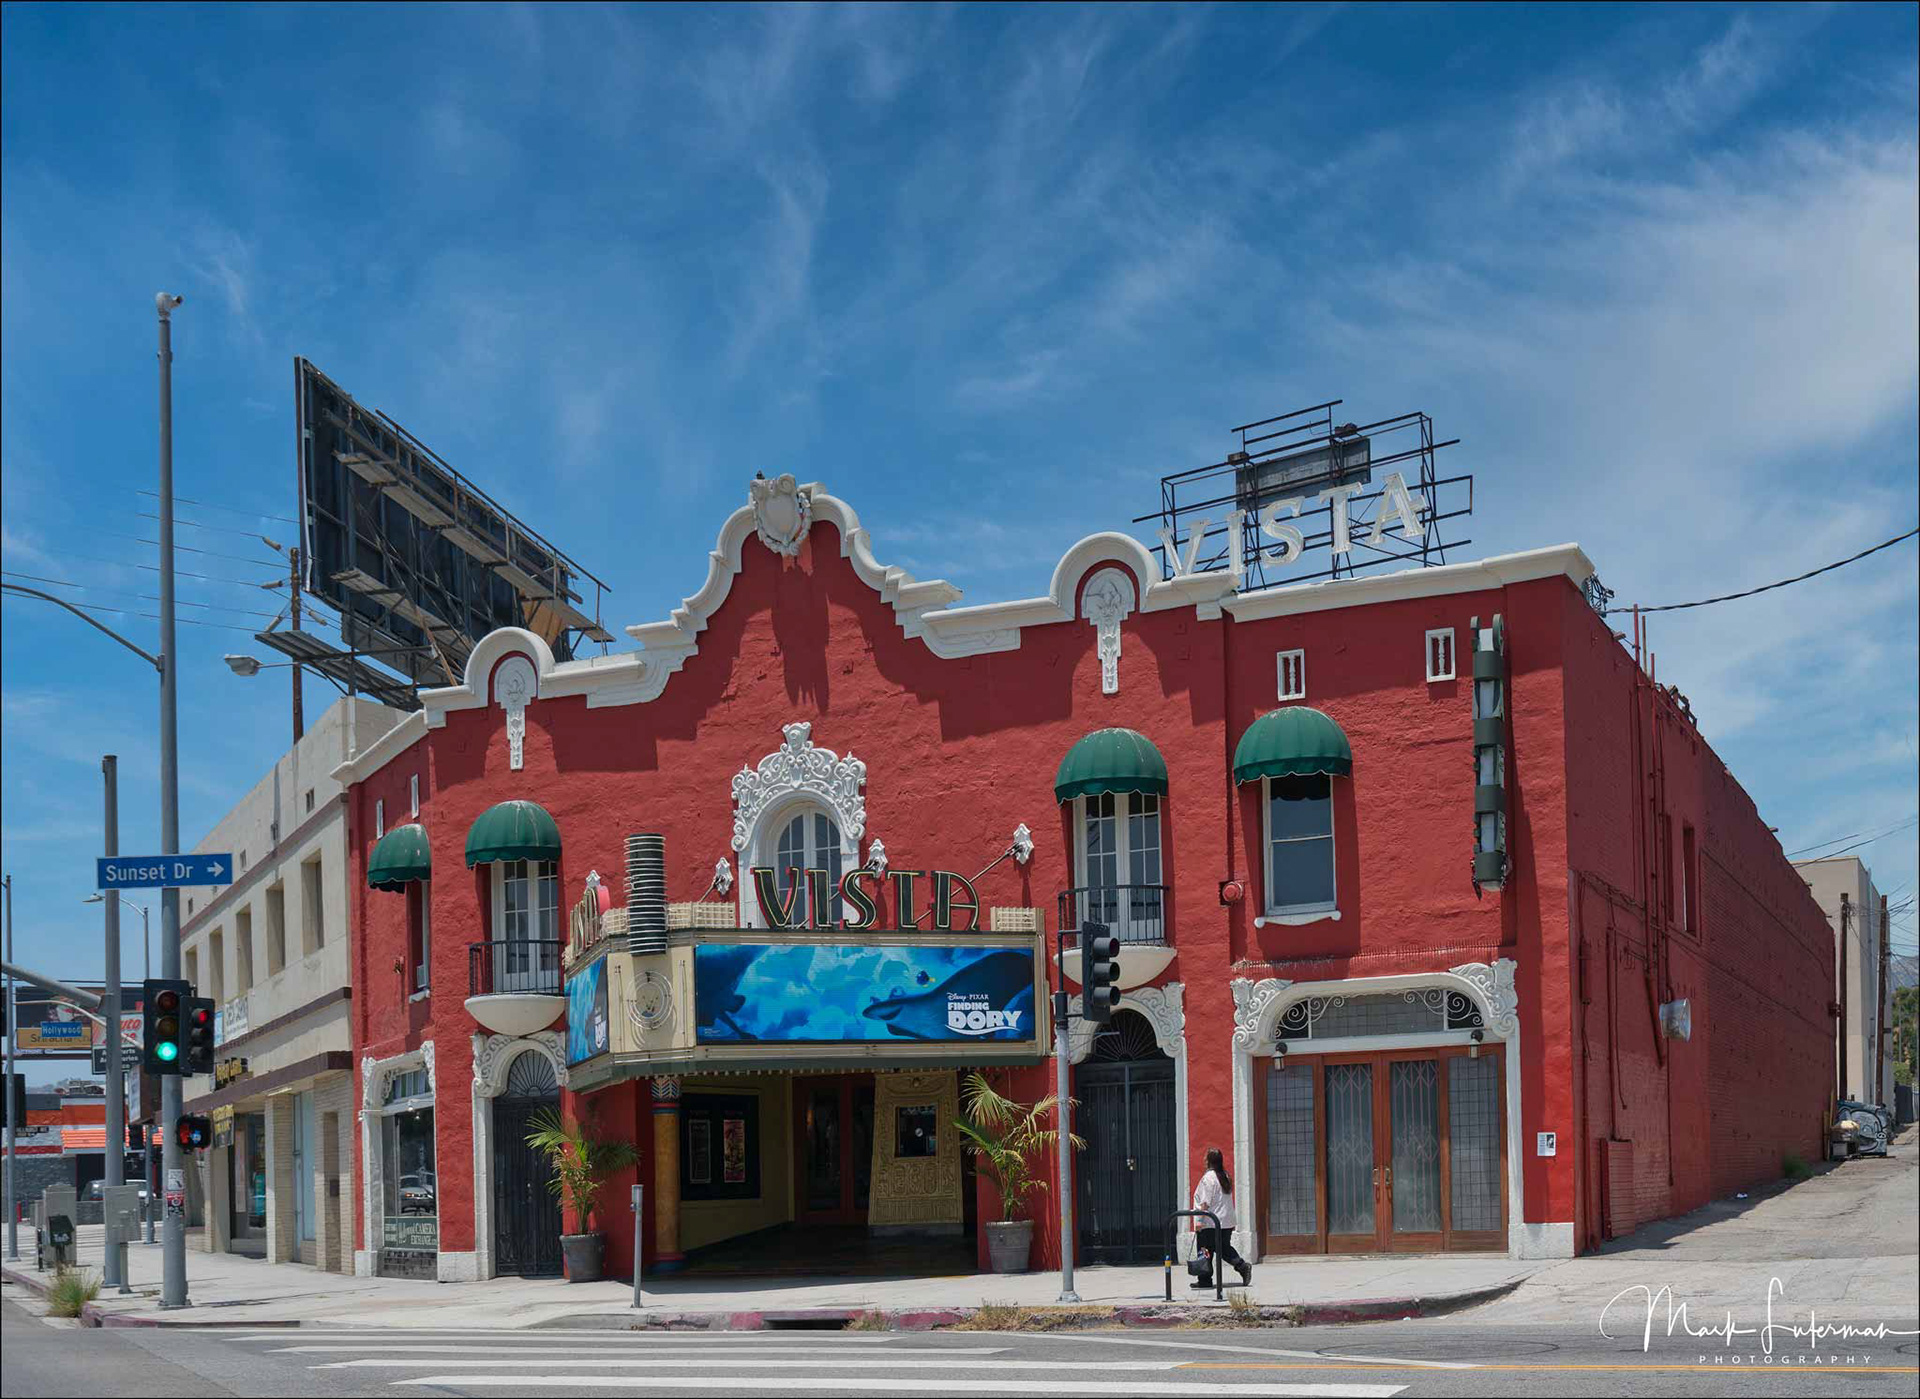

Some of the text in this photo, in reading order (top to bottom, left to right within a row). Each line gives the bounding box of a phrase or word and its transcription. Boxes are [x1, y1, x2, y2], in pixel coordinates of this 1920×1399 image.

[1155, 471, 1431, 578] VISTA
[105, 862, 194, 882] Sunset Dr
[754, 867, 981, 931] VISTA
[946, 992, 967, 1002] Disney
[947, 1002, 990, 1011] FINDING
[947, 1010, 1022, 1030] DORY
[42, 1027, 82, 1035] Hollywood
